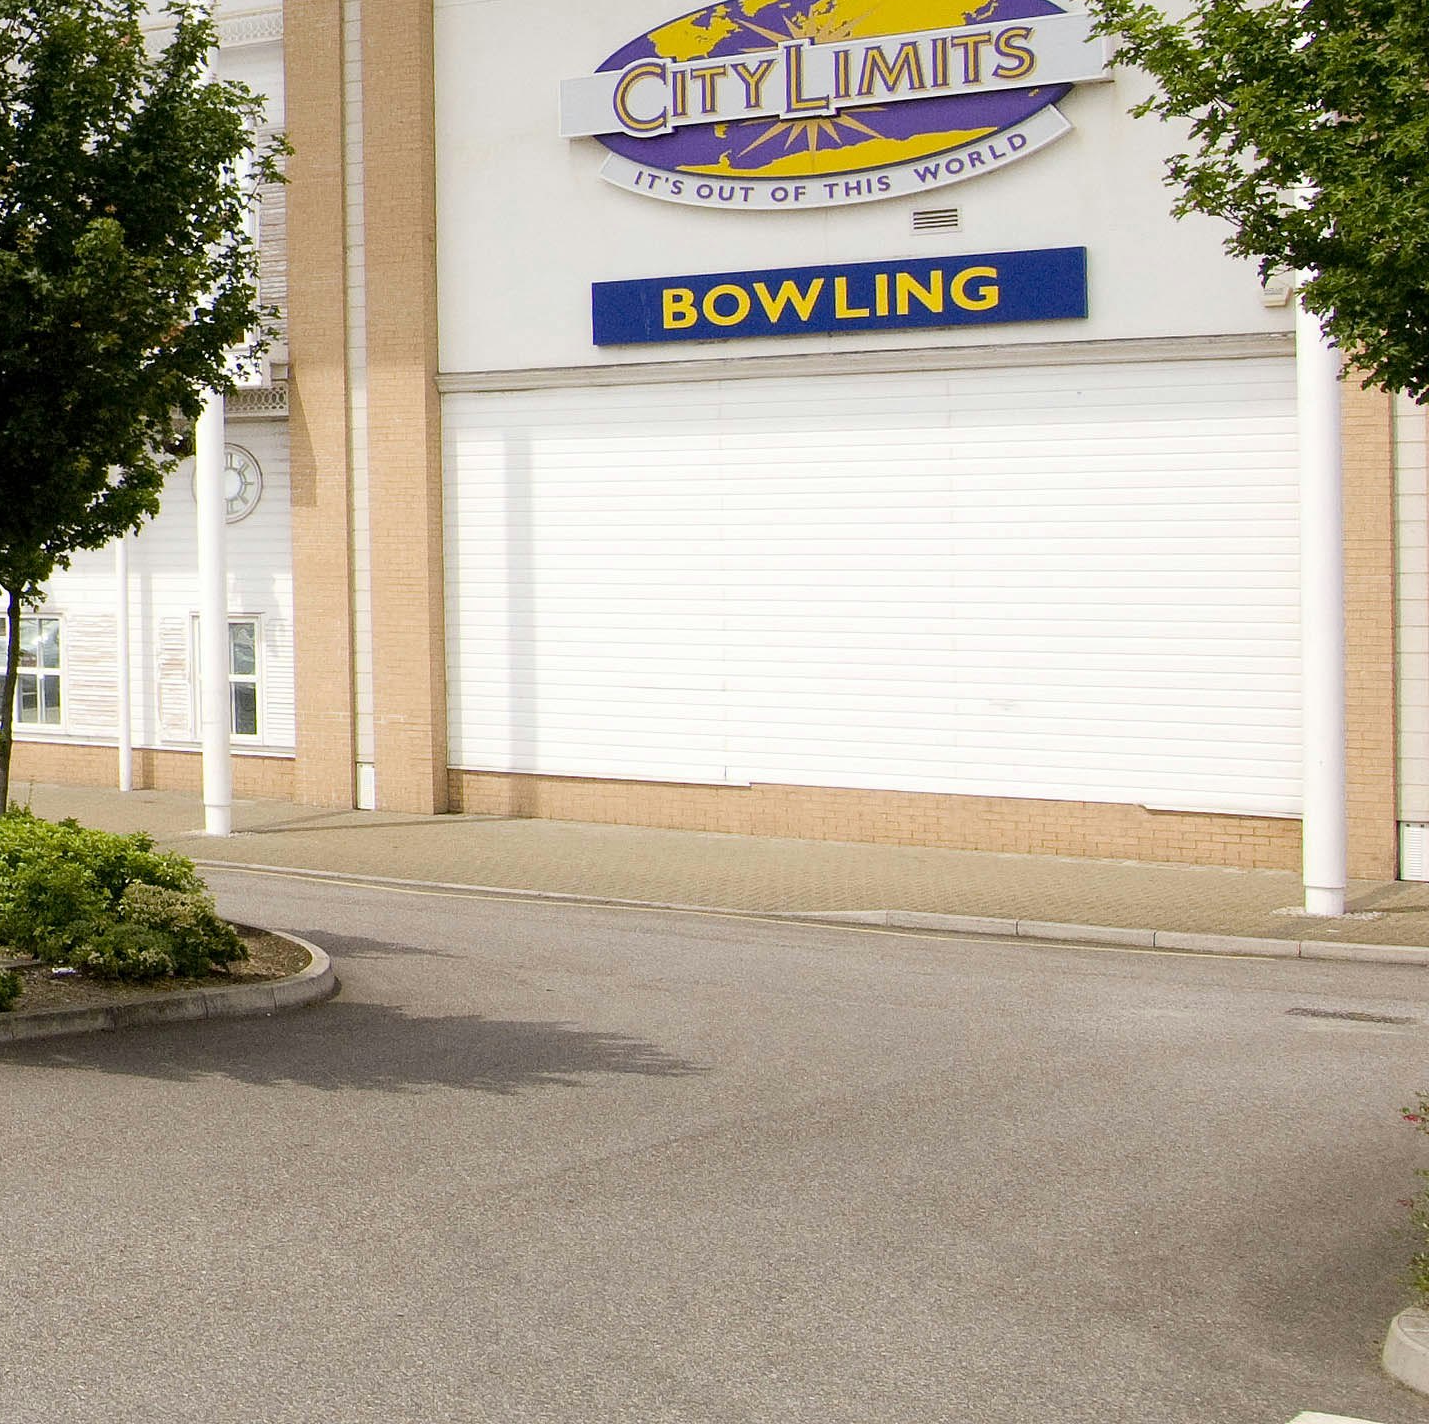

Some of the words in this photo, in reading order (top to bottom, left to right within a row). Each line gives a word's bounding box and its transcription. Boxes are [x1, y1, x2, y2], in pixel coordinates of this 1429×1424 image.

[634, 170, 685, 195] IT'S
[696, 183, 755, 203] OUT
[770, 185, 807, 203] OF
[823, 176, 892, 199] THIS
[913, 133, 1028, 183] WORLD
[662, 266, 1000, 330] BOWLING
